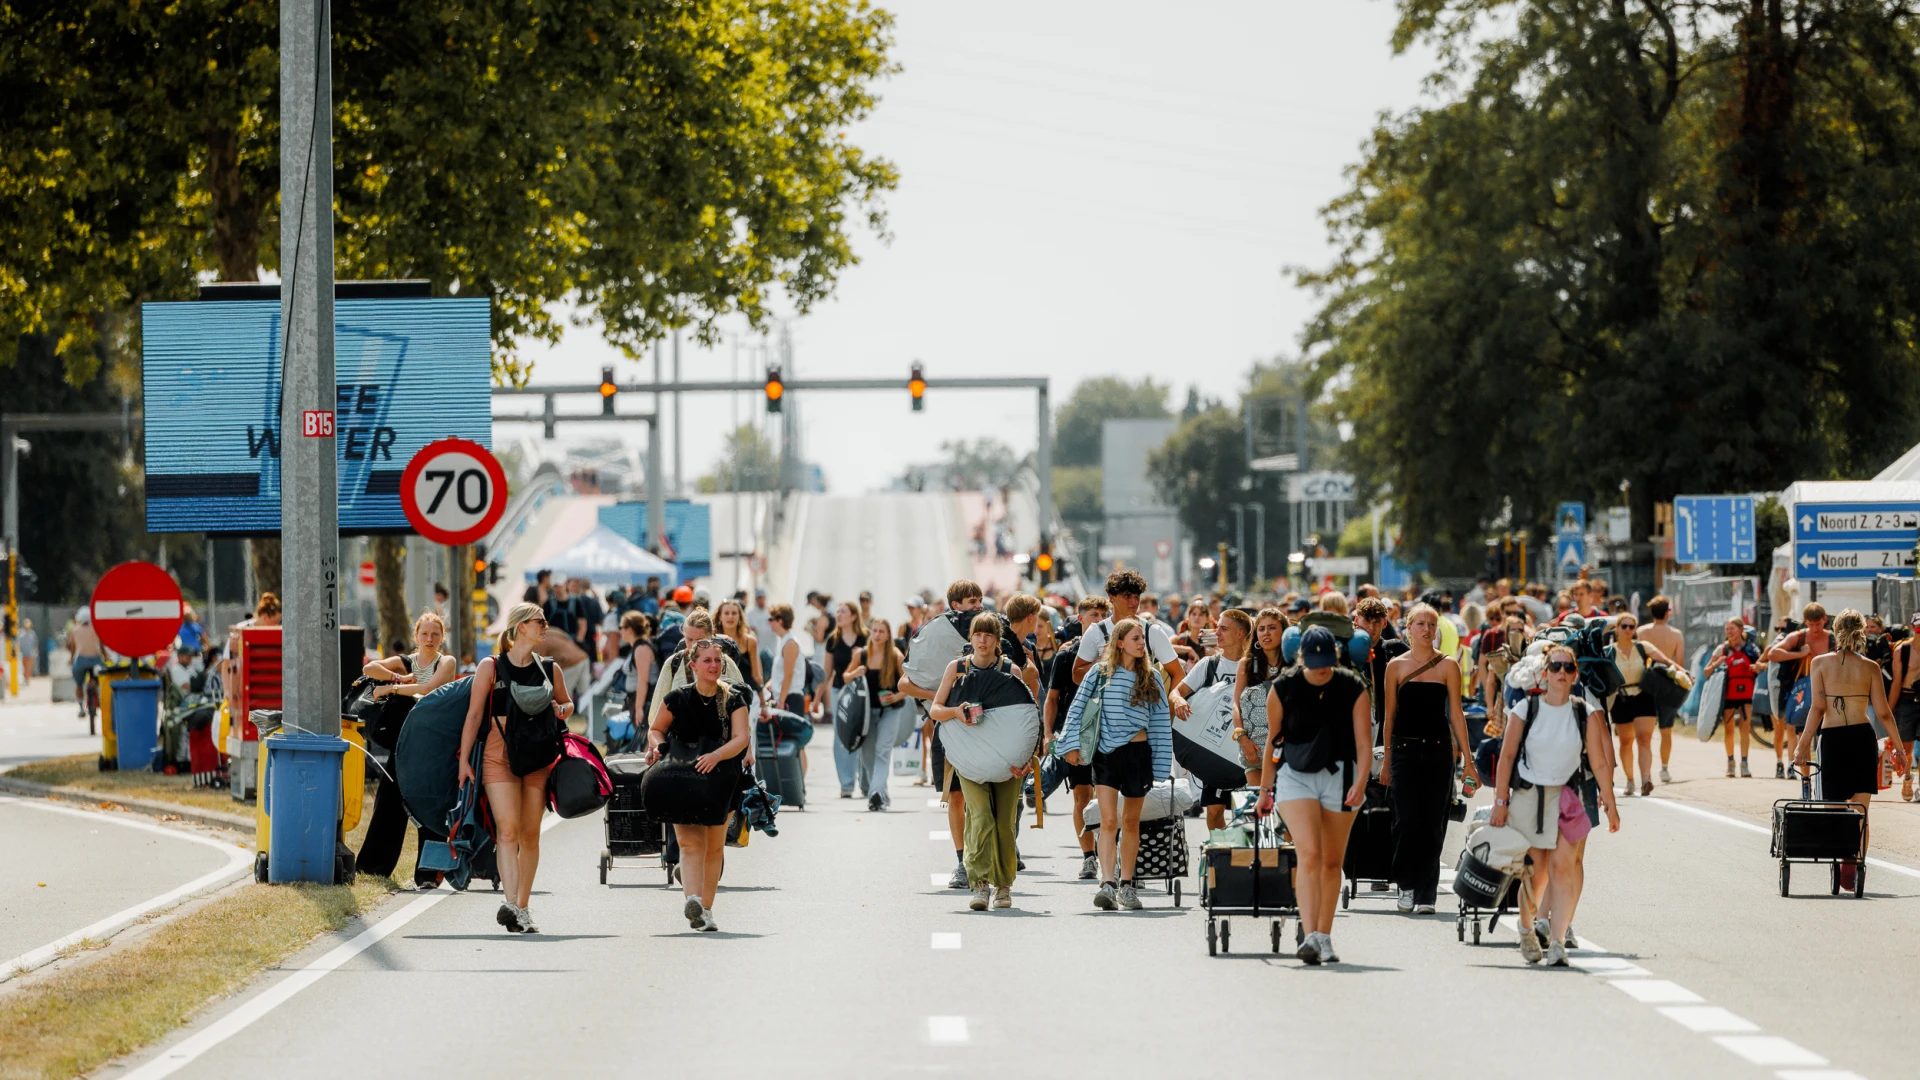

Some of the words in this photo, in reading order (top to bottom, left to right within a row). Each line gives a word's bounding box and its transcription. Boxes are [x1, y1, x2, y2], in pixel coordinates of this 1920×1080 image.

[305, 412, 333, 435] B15
[246, 426, 397, 461] WER
[425, 468, 489, 515] 70
[1820, 515, 1857, 529] Noord
[1860, 514, 1872, 529] Z.
[1821, 552, 1858, 568] Noord
